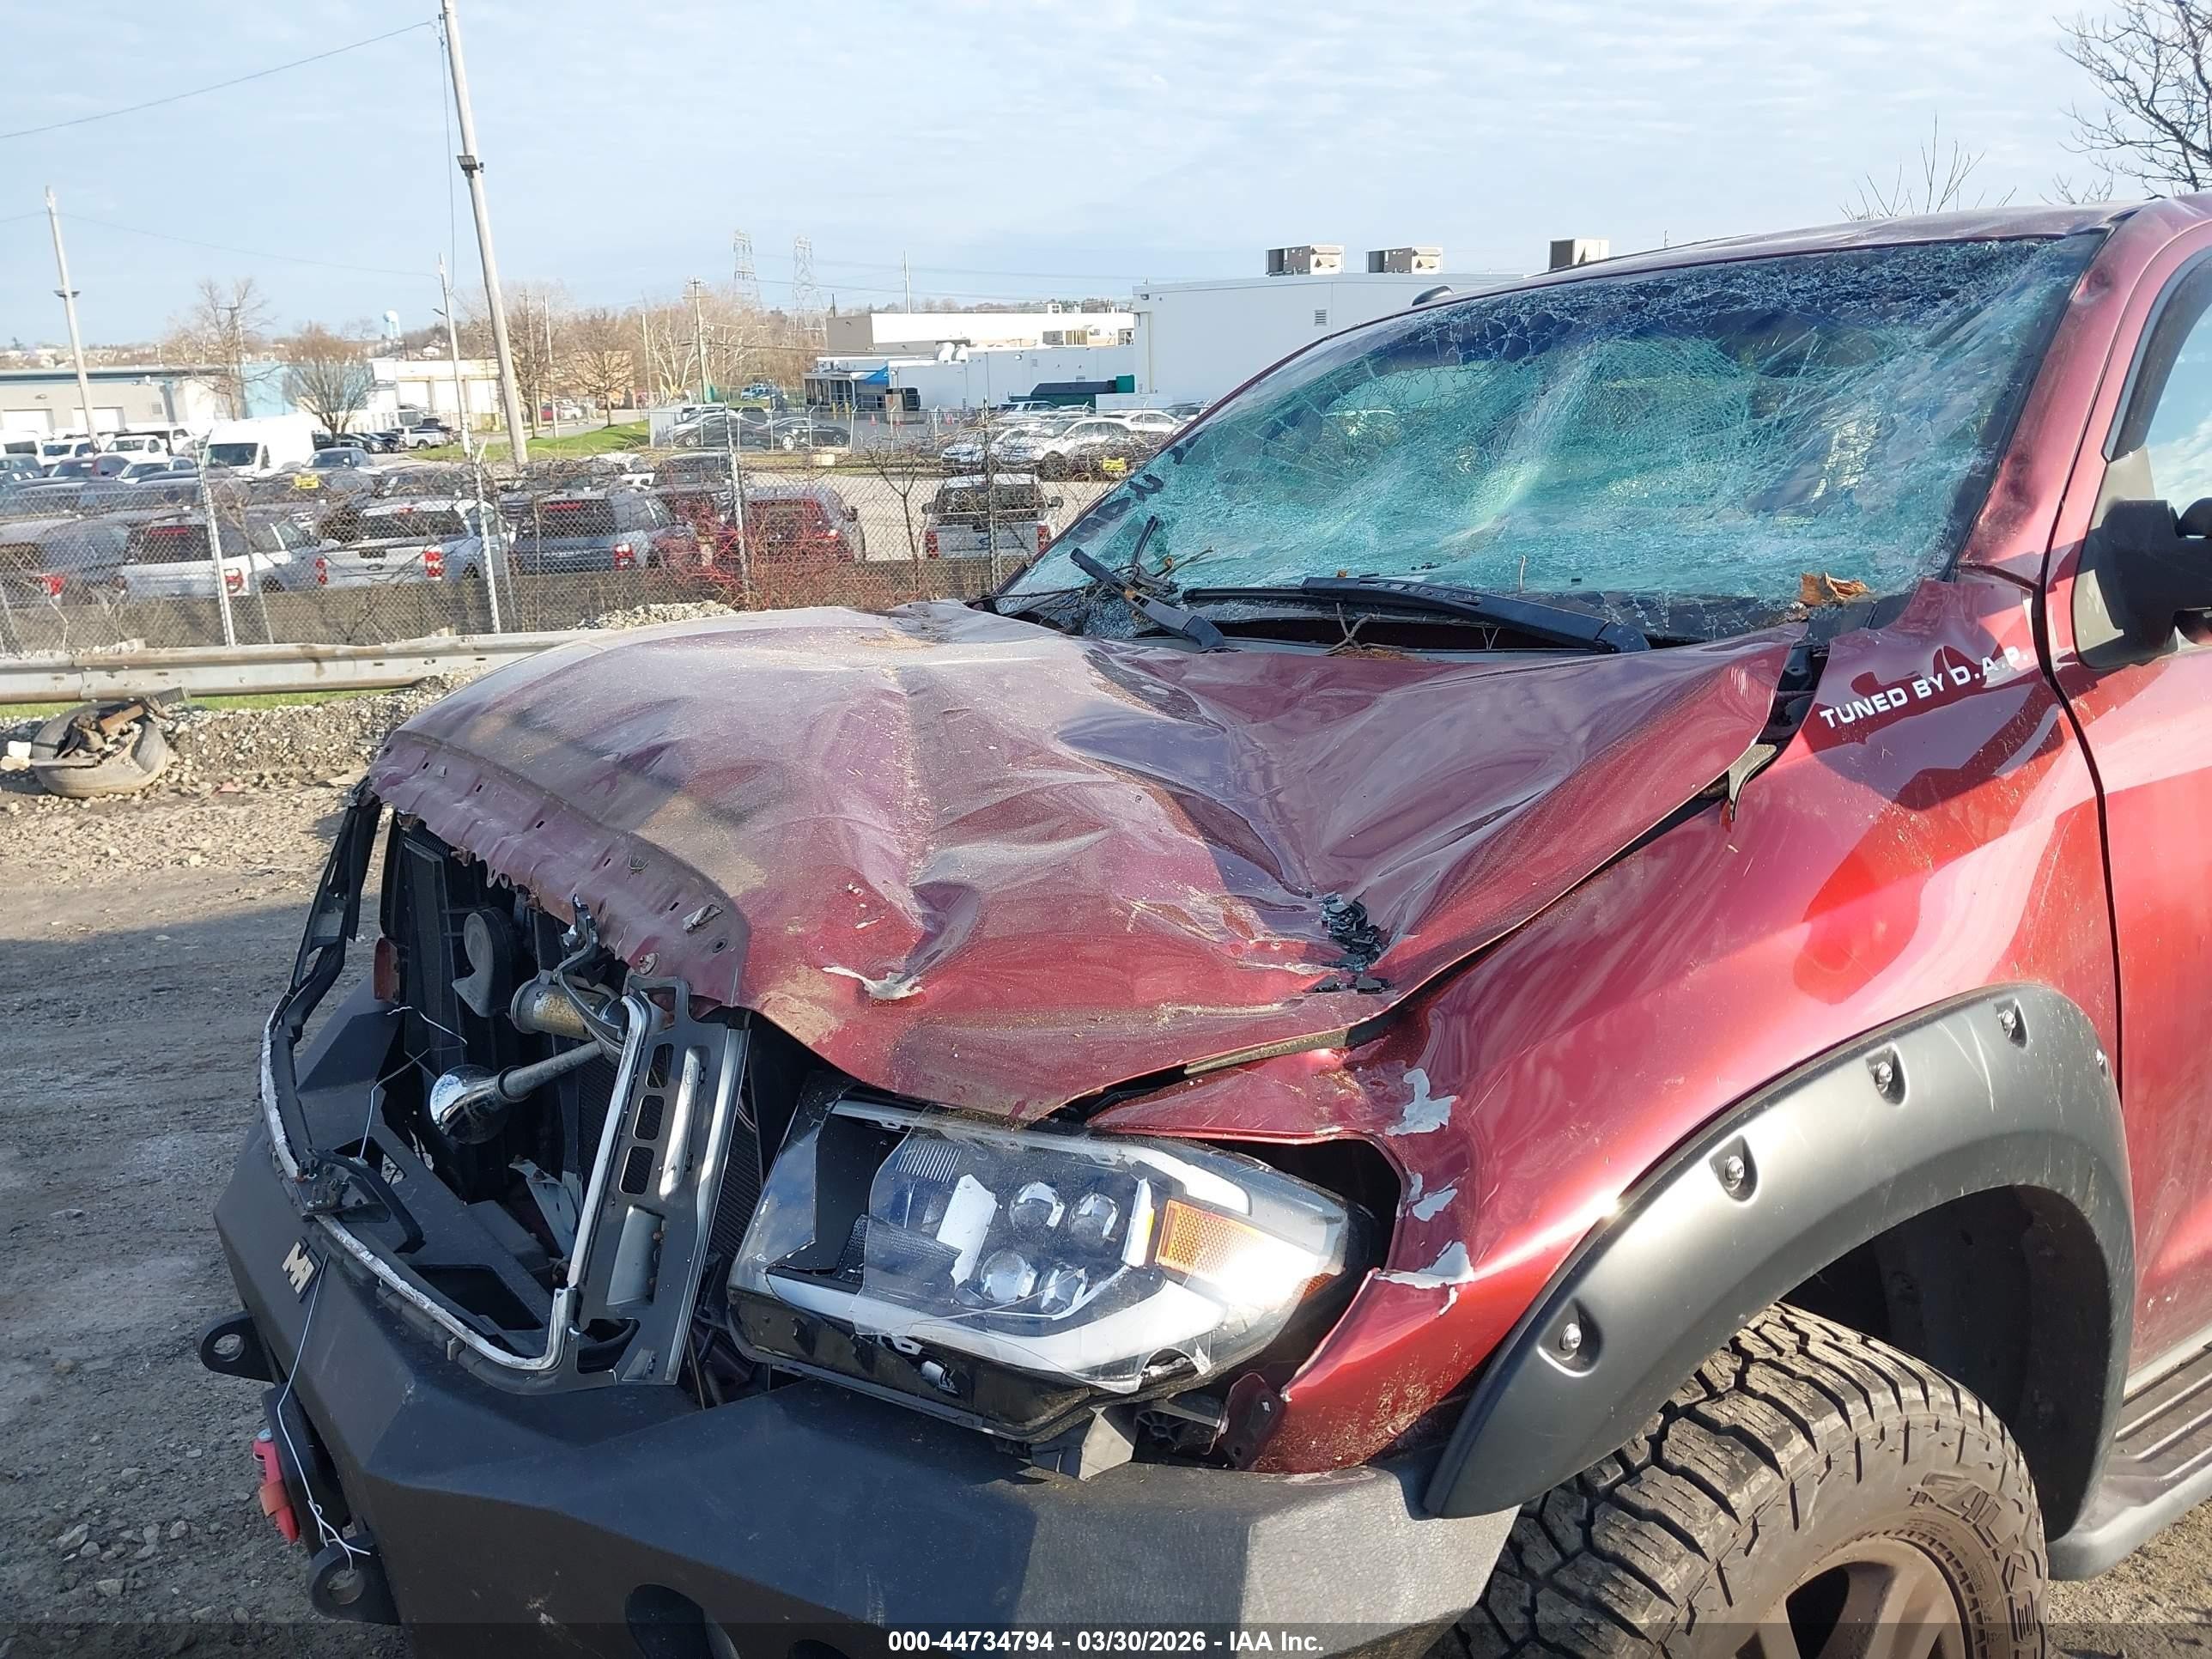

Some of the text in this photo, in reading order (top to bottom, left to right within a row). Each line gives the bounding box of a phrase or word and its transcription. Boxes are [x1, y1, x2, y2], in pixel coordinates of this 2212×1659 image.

[1819, 645, 2029, 729] TUNED BY D.A.P.
